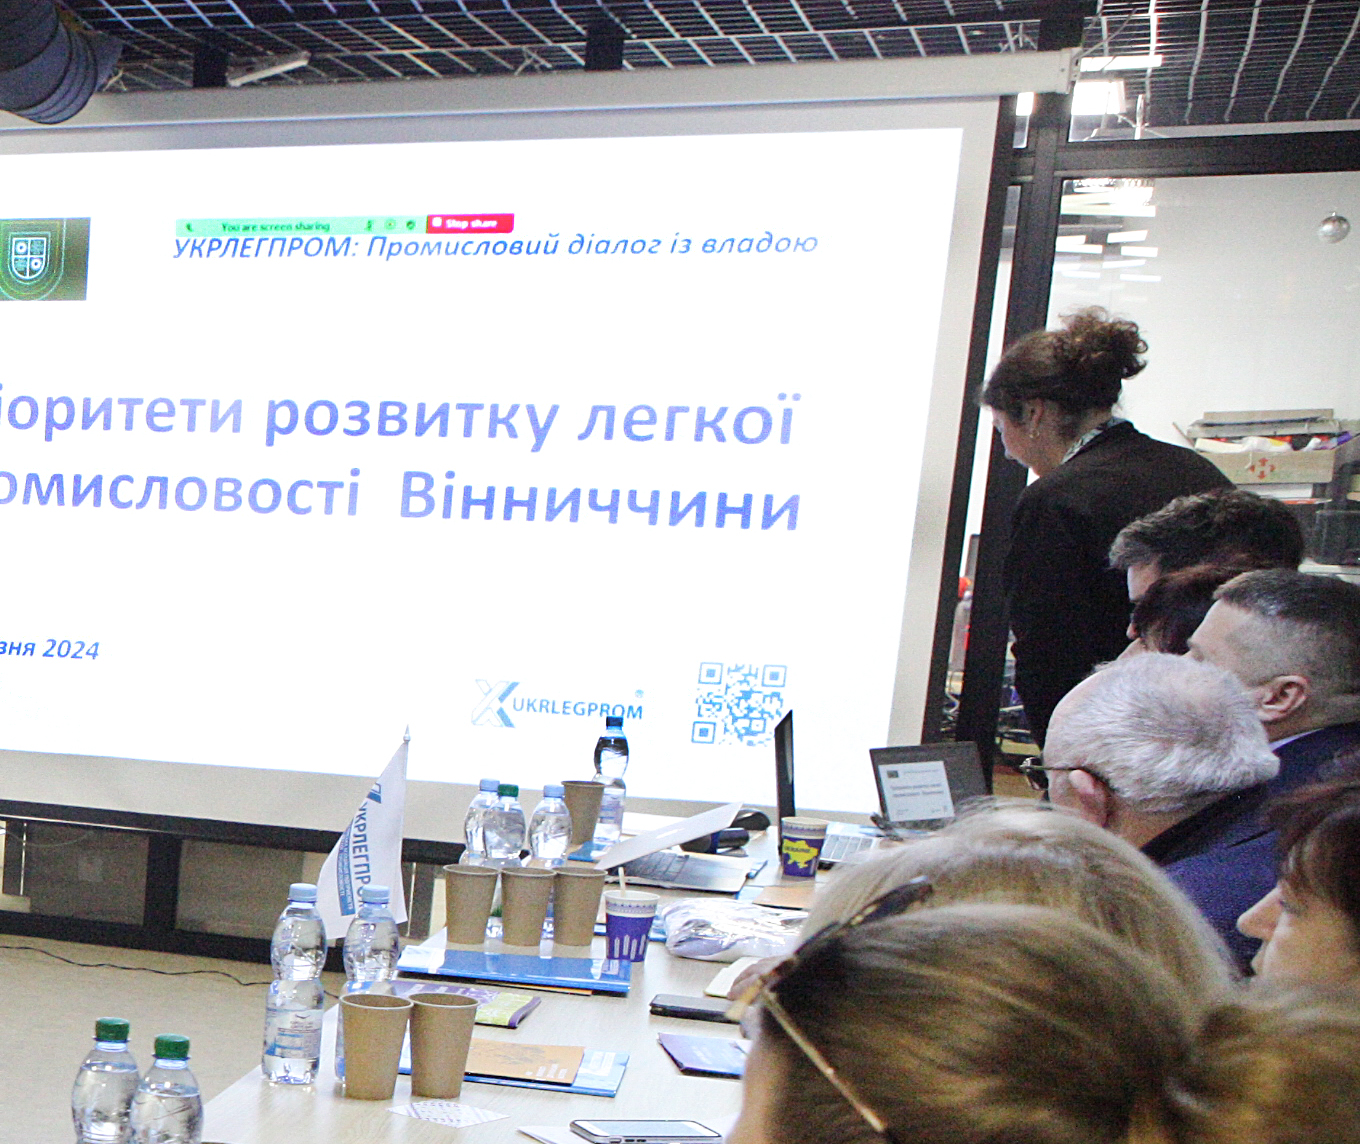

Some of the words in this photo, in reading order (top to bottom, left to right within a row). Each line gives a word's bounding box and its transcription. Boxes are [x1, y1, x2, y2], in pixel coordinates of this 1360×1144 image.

[259, 223, 293, 231] screen
[294, 221, 330, 233] sharing
[173, 237, 358, 259] УКРЛЕГПРОМ:
[367, 234, 559, 261] Промисловий
[568, 234, 661, 256] діалог
[670, 233, 691, 254] із
[701, 230, 819, 254] владою
[265, 399, 560, 453] розвитку
[577, 392, 802, 445] легкої
[400, 469, 801, 531] Вінниччини
[42, 638, 100, 660] 2024
[513, 697, 644, 720] UKRLEGPROM
